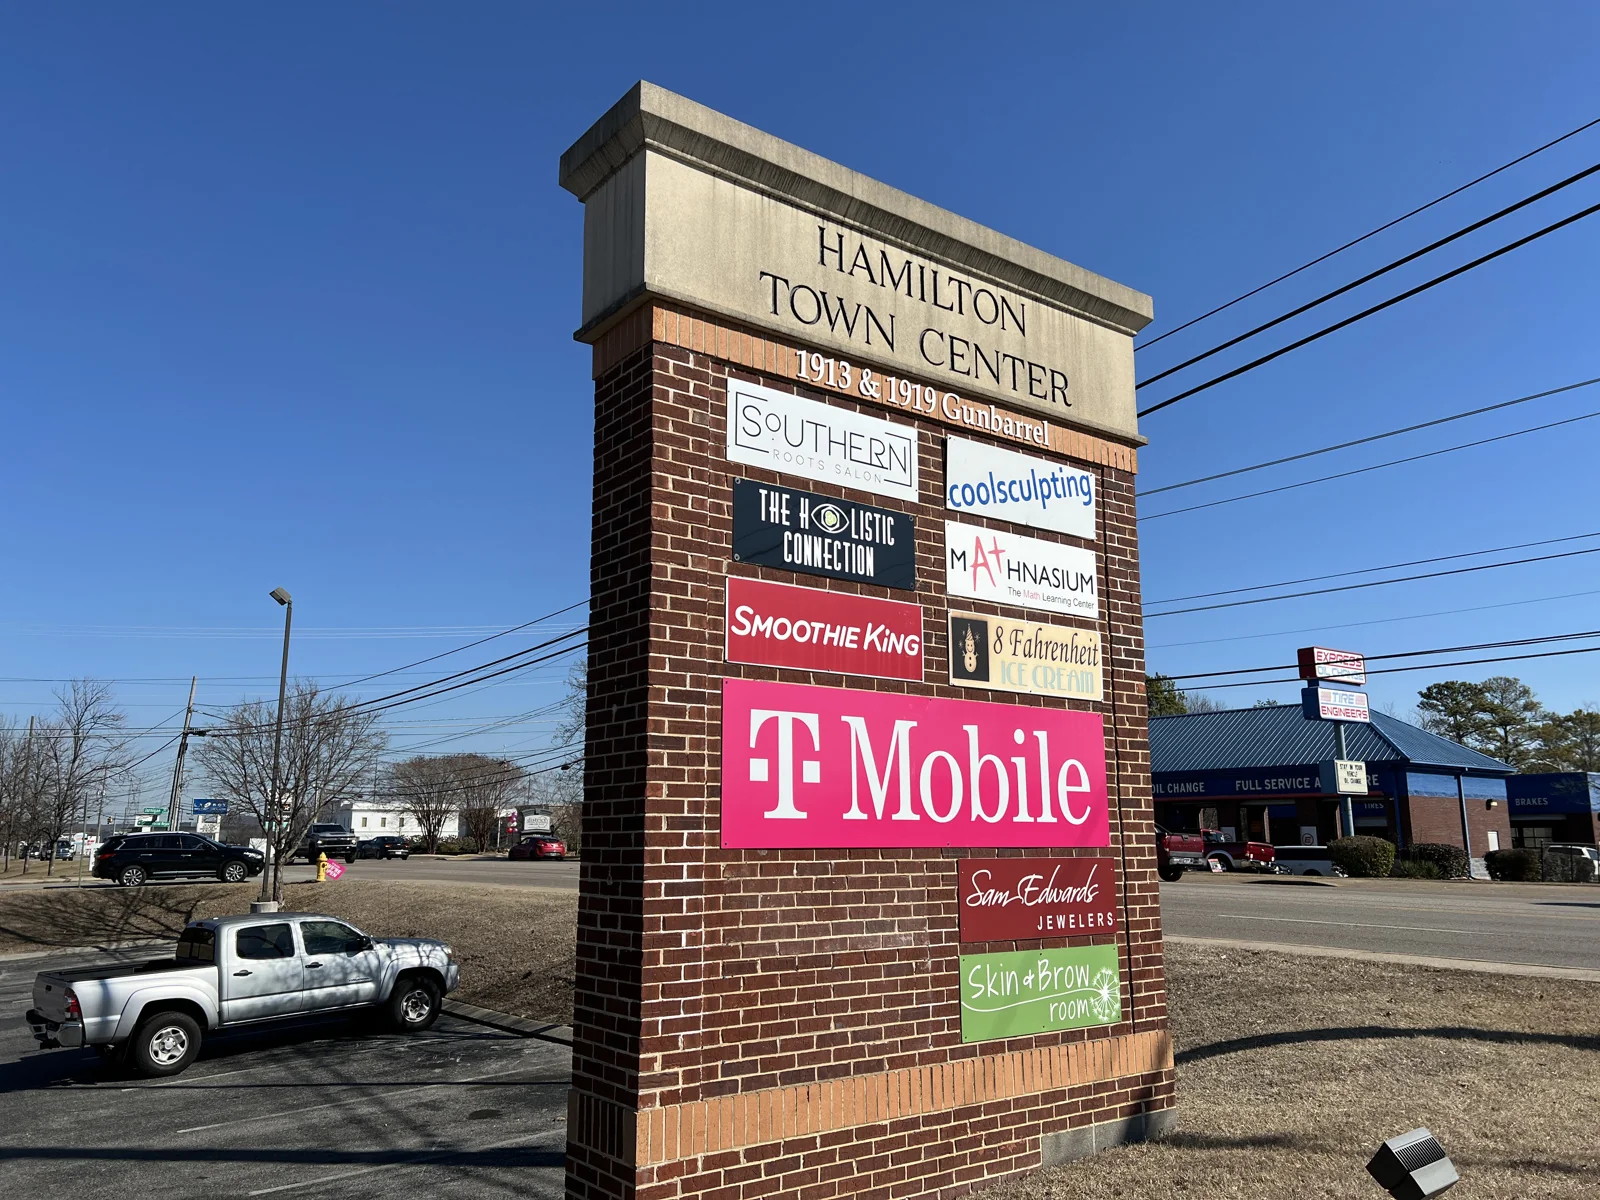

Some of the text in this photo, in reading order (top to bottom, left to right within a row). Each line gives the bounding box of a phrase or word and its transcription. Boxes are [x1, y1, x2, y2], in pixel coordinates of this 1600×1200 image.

[817, 225, 1027, 338] HAMILTON
[758, 270, 1073, 408] TOWN CENTER
[795, 349, 1051, 447] 1913 & 1919 Gunbarrel
[773, 448, 883, 484] ROOTS SALON
[949, 466, 1093, 510] coolsculpting
[759, 488, 791, 527] THE
[783, 530, 875, 578] CONNECTION
[1007, 586, 1095, 610] The Math Learning Center
[730, 604, 861, 650] SMOOTHIE
[993, 625, 1100, 667] 8 Fahrenheit
[1316, 651, 1362, 667] EXPRESS
[1000, 659, 1095, 694] ICE CREAM
[1317, 665, 1330, 676] OIL
[1321, 705, 1368, 720] ENGINEERS
[1332, 692, 1355, 705] TIRE
[840, 715, 1092, 826] Mobile
[1167, 781, 1206, 793] CHANGE
[1235, 779, 1262, 791] FULL
[1264, 777, 1311, 790] SERVICE
[1364, 802, 1384, 810] TIRES
[1514, 797, 1549, 807] BRAKES
[966, 864, 1099, 907] Sam Edwards
[1037, 911, 1114, 931] JEWELERS
[968, 963, 1019, 999] Skin
[1037, 958, 1090, 992] Brow
[1050, 997, 1090, 1022] room
